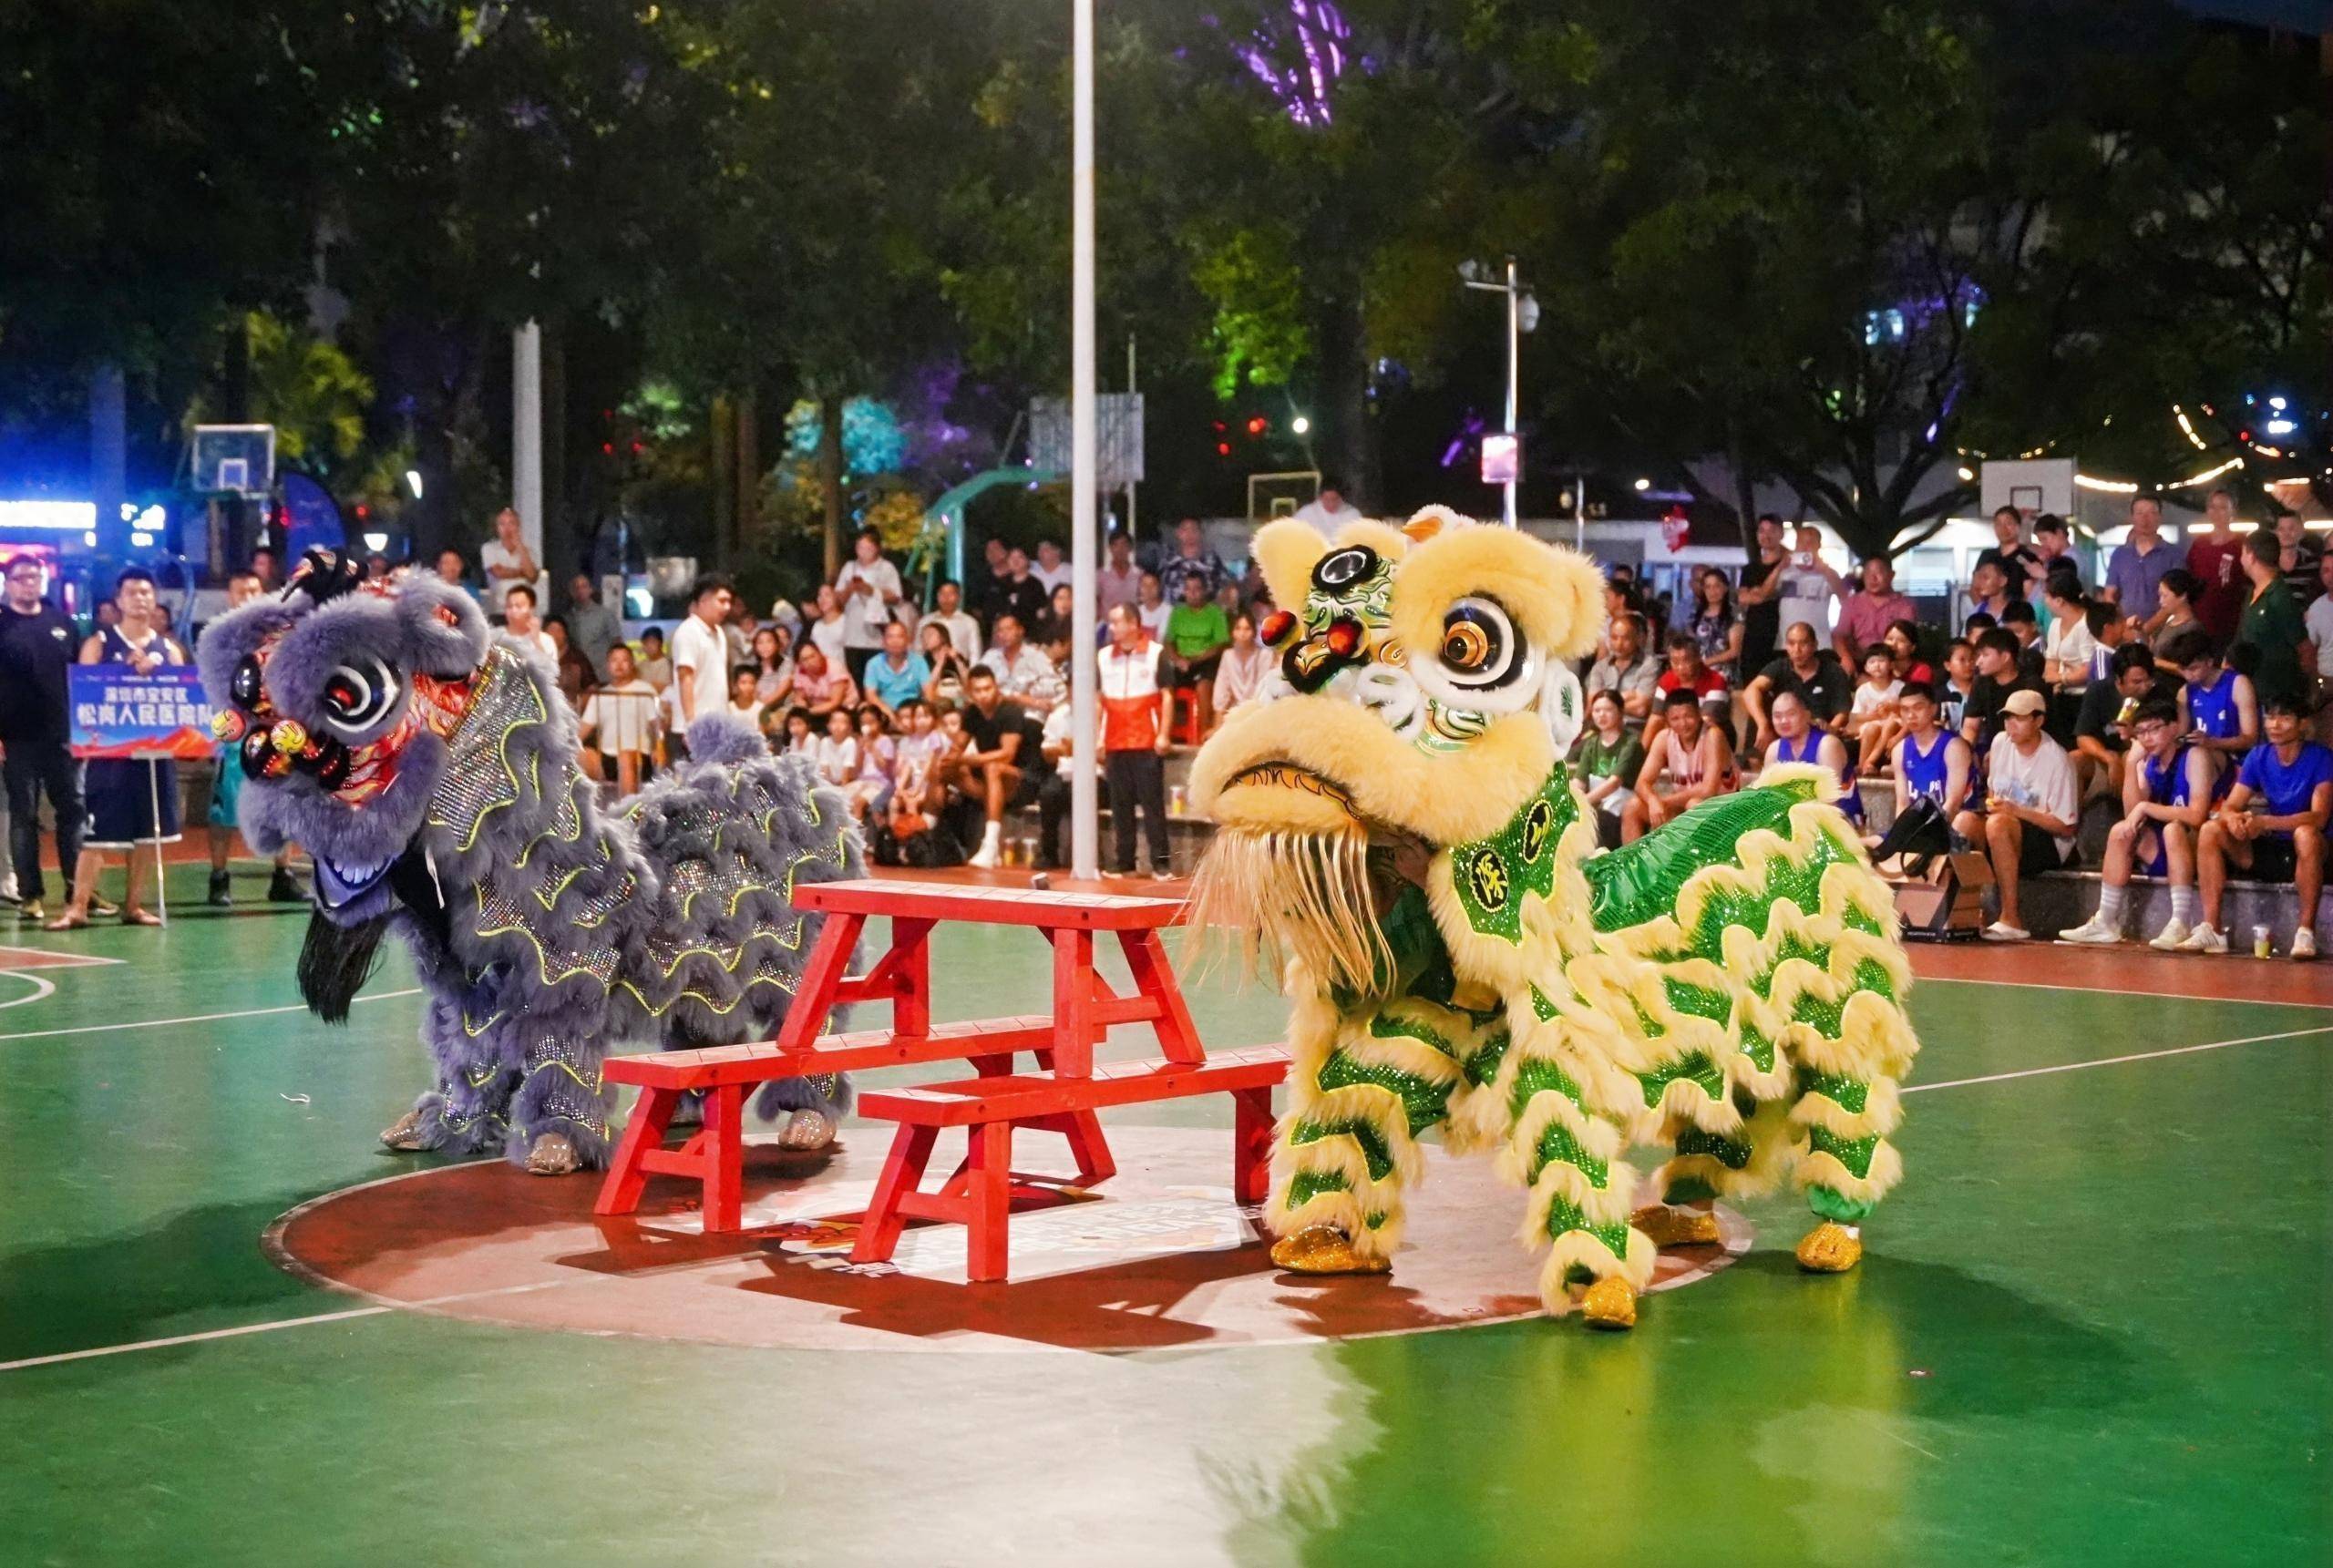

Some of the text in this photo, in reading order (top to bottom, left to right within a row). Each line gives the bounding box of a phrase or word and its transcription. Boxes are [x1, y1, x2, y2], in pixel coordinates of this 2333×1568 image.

[105, 687, 188, 703] 深圳市宝安区
